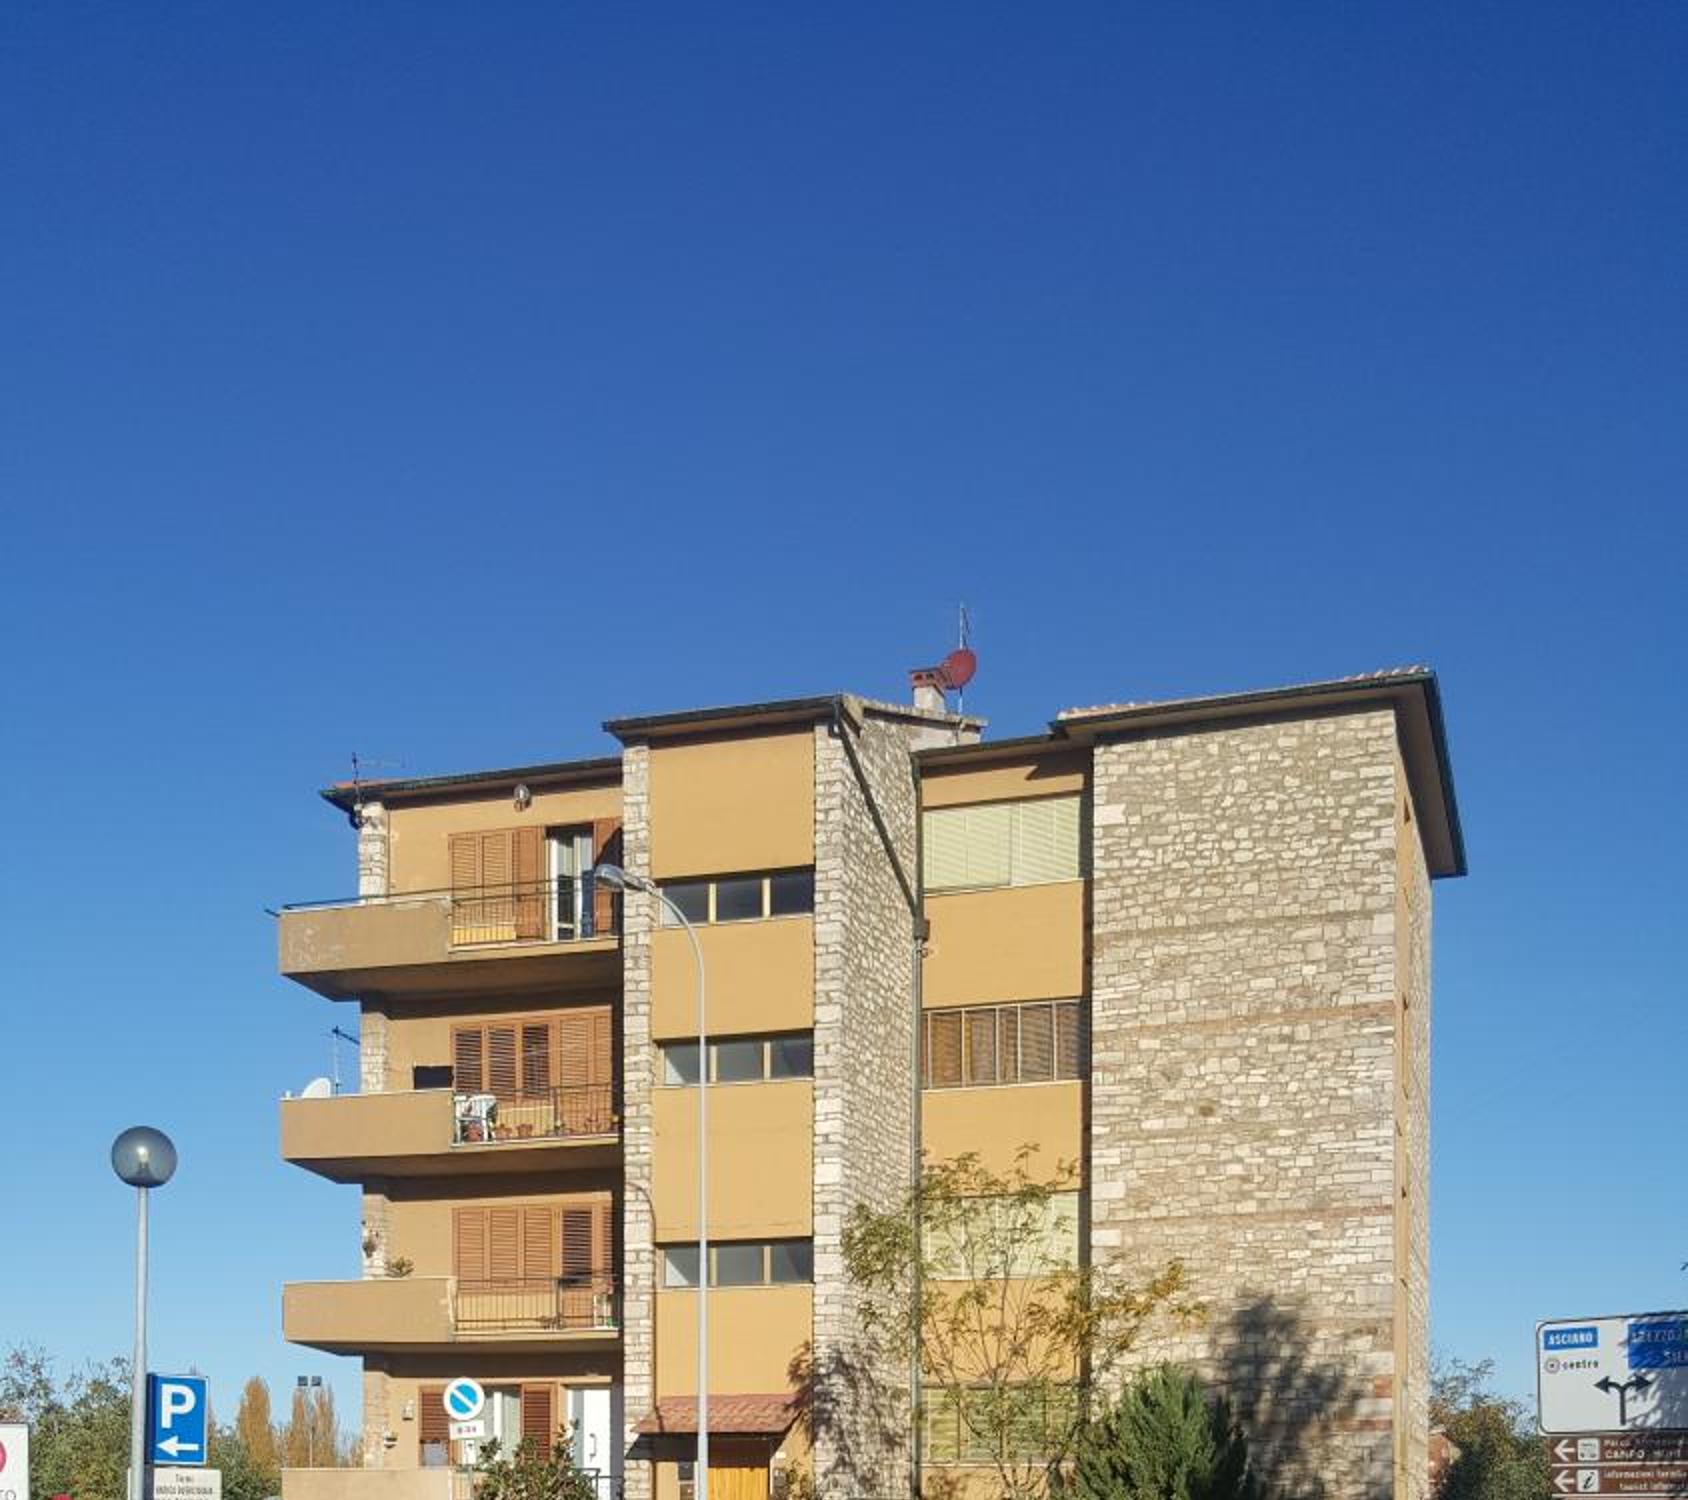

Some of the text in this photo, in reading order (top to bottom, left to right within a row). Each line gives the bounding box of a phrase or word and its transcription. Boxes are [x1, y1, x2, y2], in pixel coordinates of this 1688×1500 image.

[1548, 1332, 1593, 1345] ASCIANO
[1561, 1359, 1599, 1370] centro
[160, 1384, 197, 1429] P
